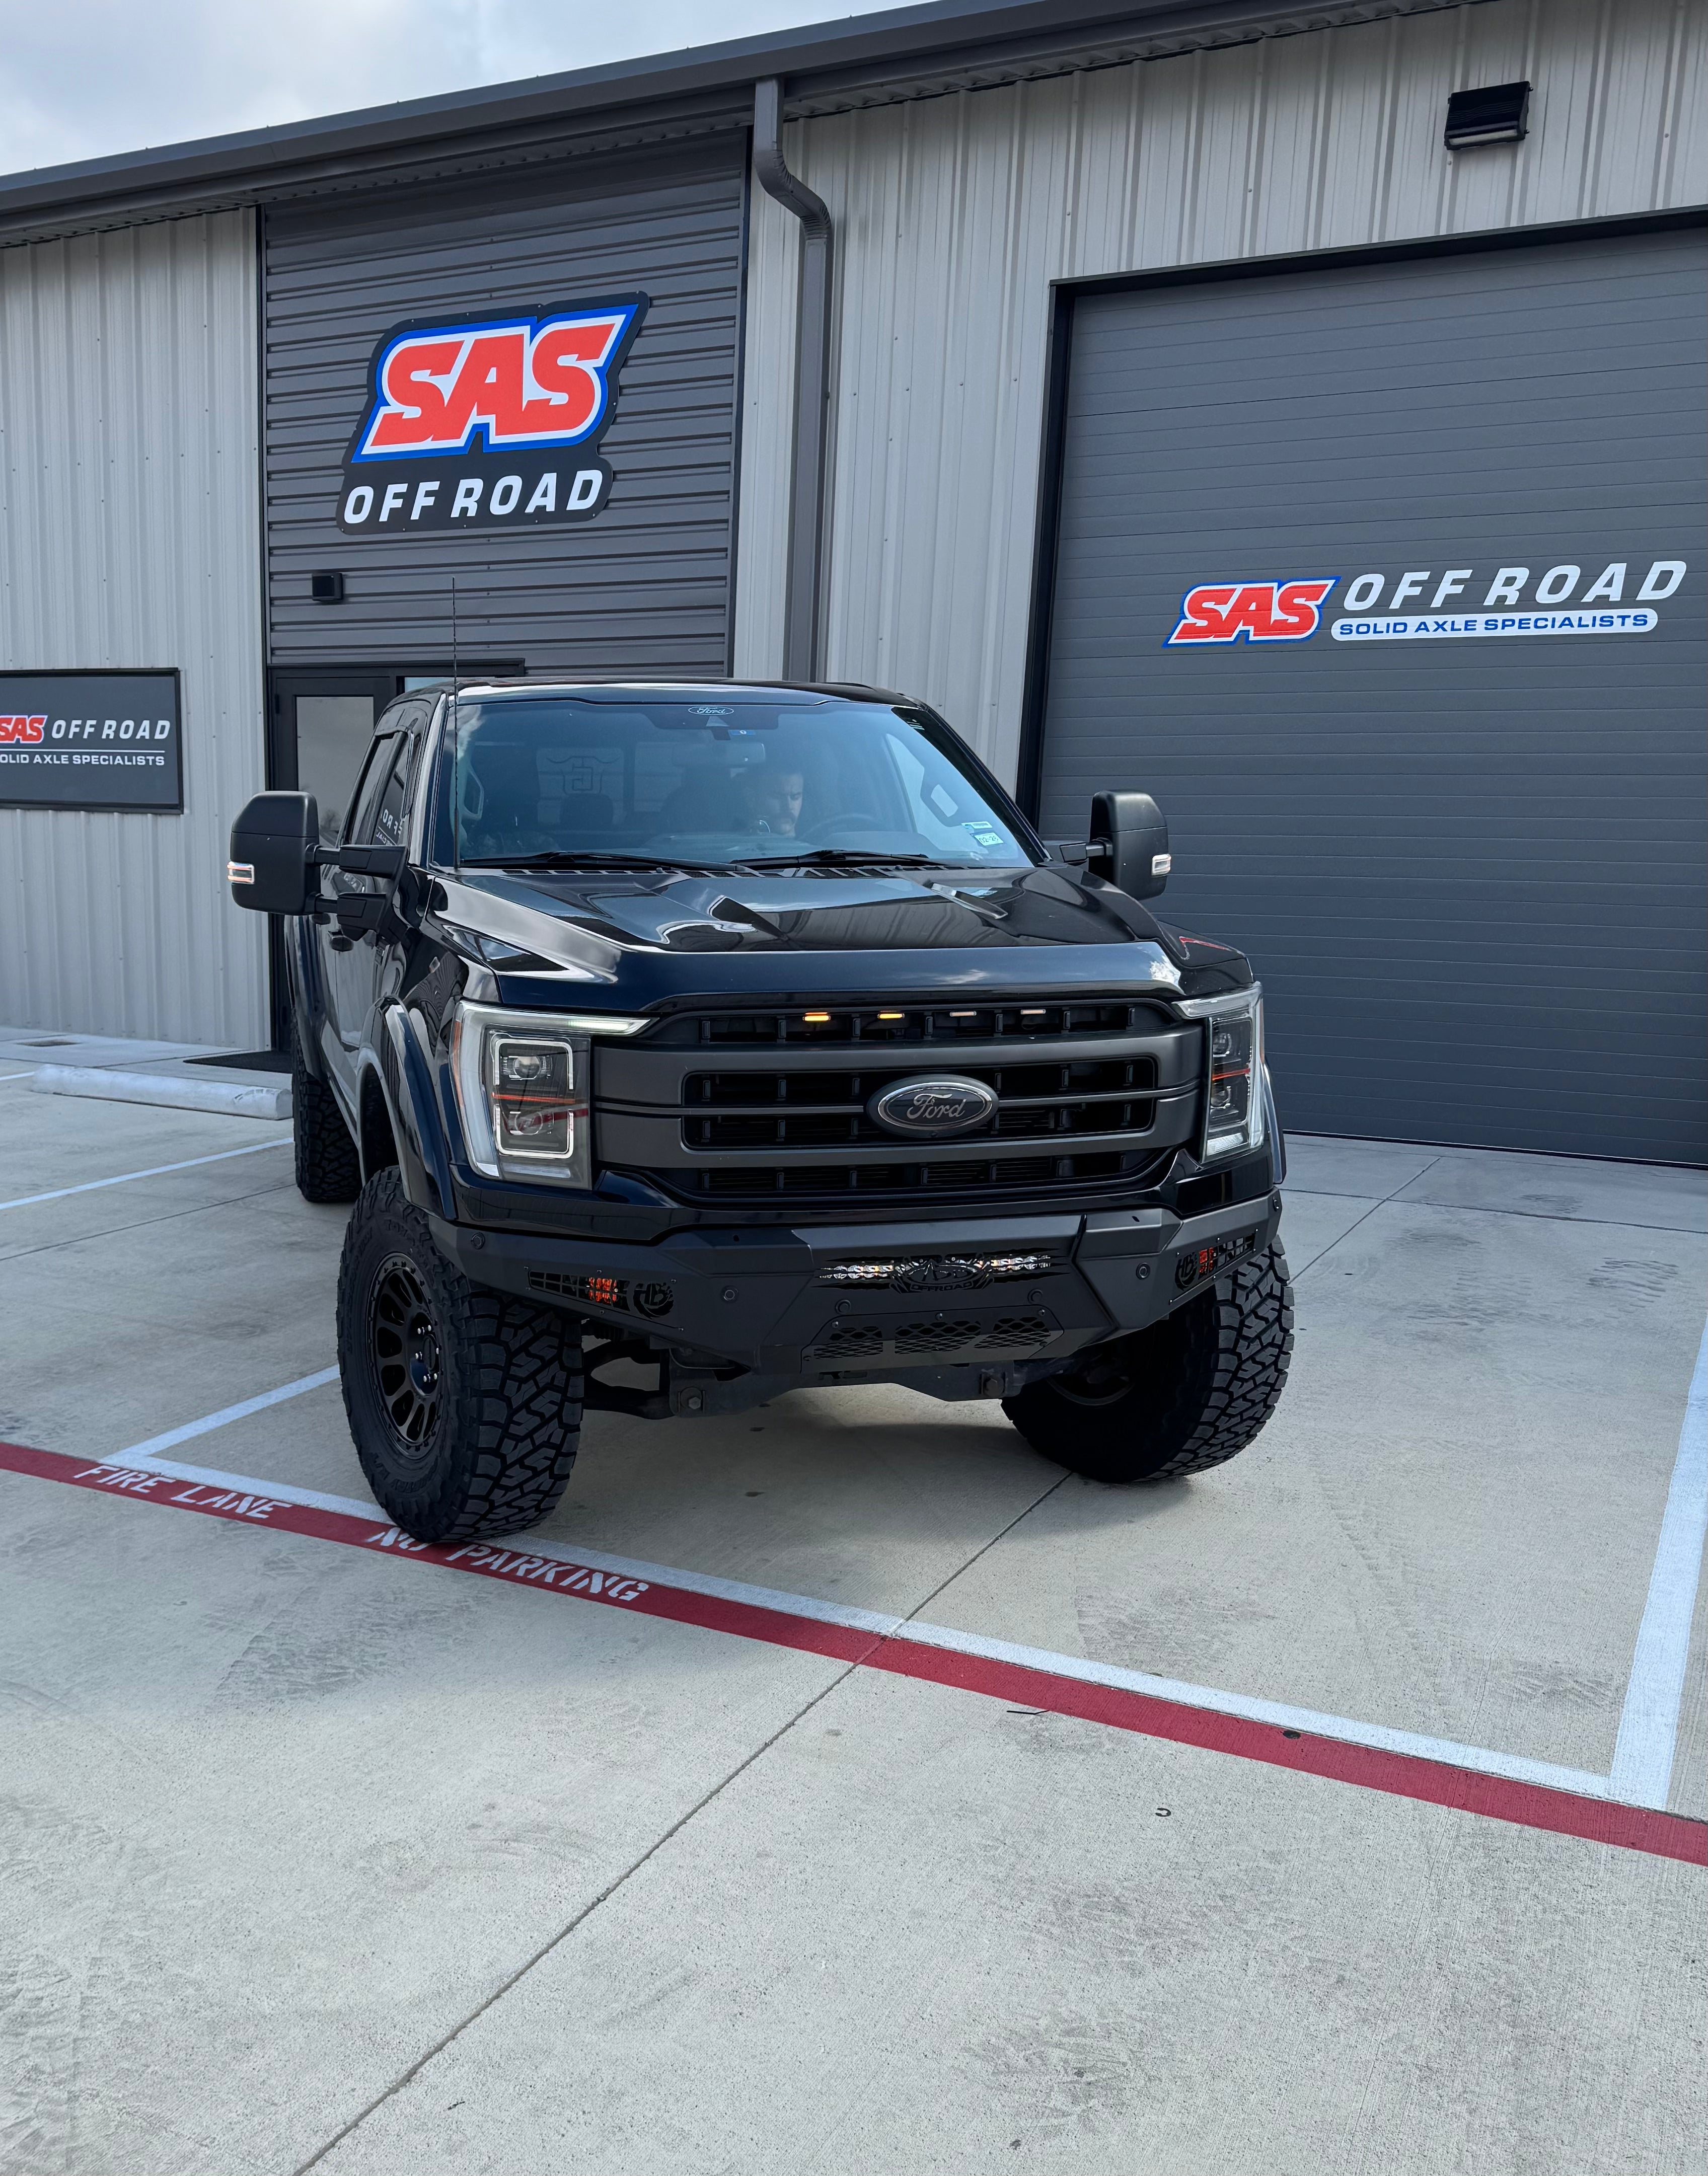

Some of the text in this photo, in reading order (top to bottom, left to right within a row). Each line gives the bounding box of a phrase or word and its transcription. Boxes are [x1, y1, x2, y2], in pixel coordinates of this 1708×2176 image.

[368, 321, 618, 448] SAS
[344, 470, 603, 524] OFF ROAD
[1172, 560, 1687, 641] SAS OFF ROAD
[1340, 614, 1648, 635] SOLID AXLE SPECIALISTS
[51, 720, 97, 739] OFF
[102, 720, 170, 739] ROAD
[0, 754, 165, 766] OLID AXLE SPECIALISTS
[906, 1093, 967, 1119] Ford
[911, 1282, 972, 1292] OFFROAD
[73, 1465, 292, 1519] FIRE LANE
[445, 1544, 649, 1601] PARKING
